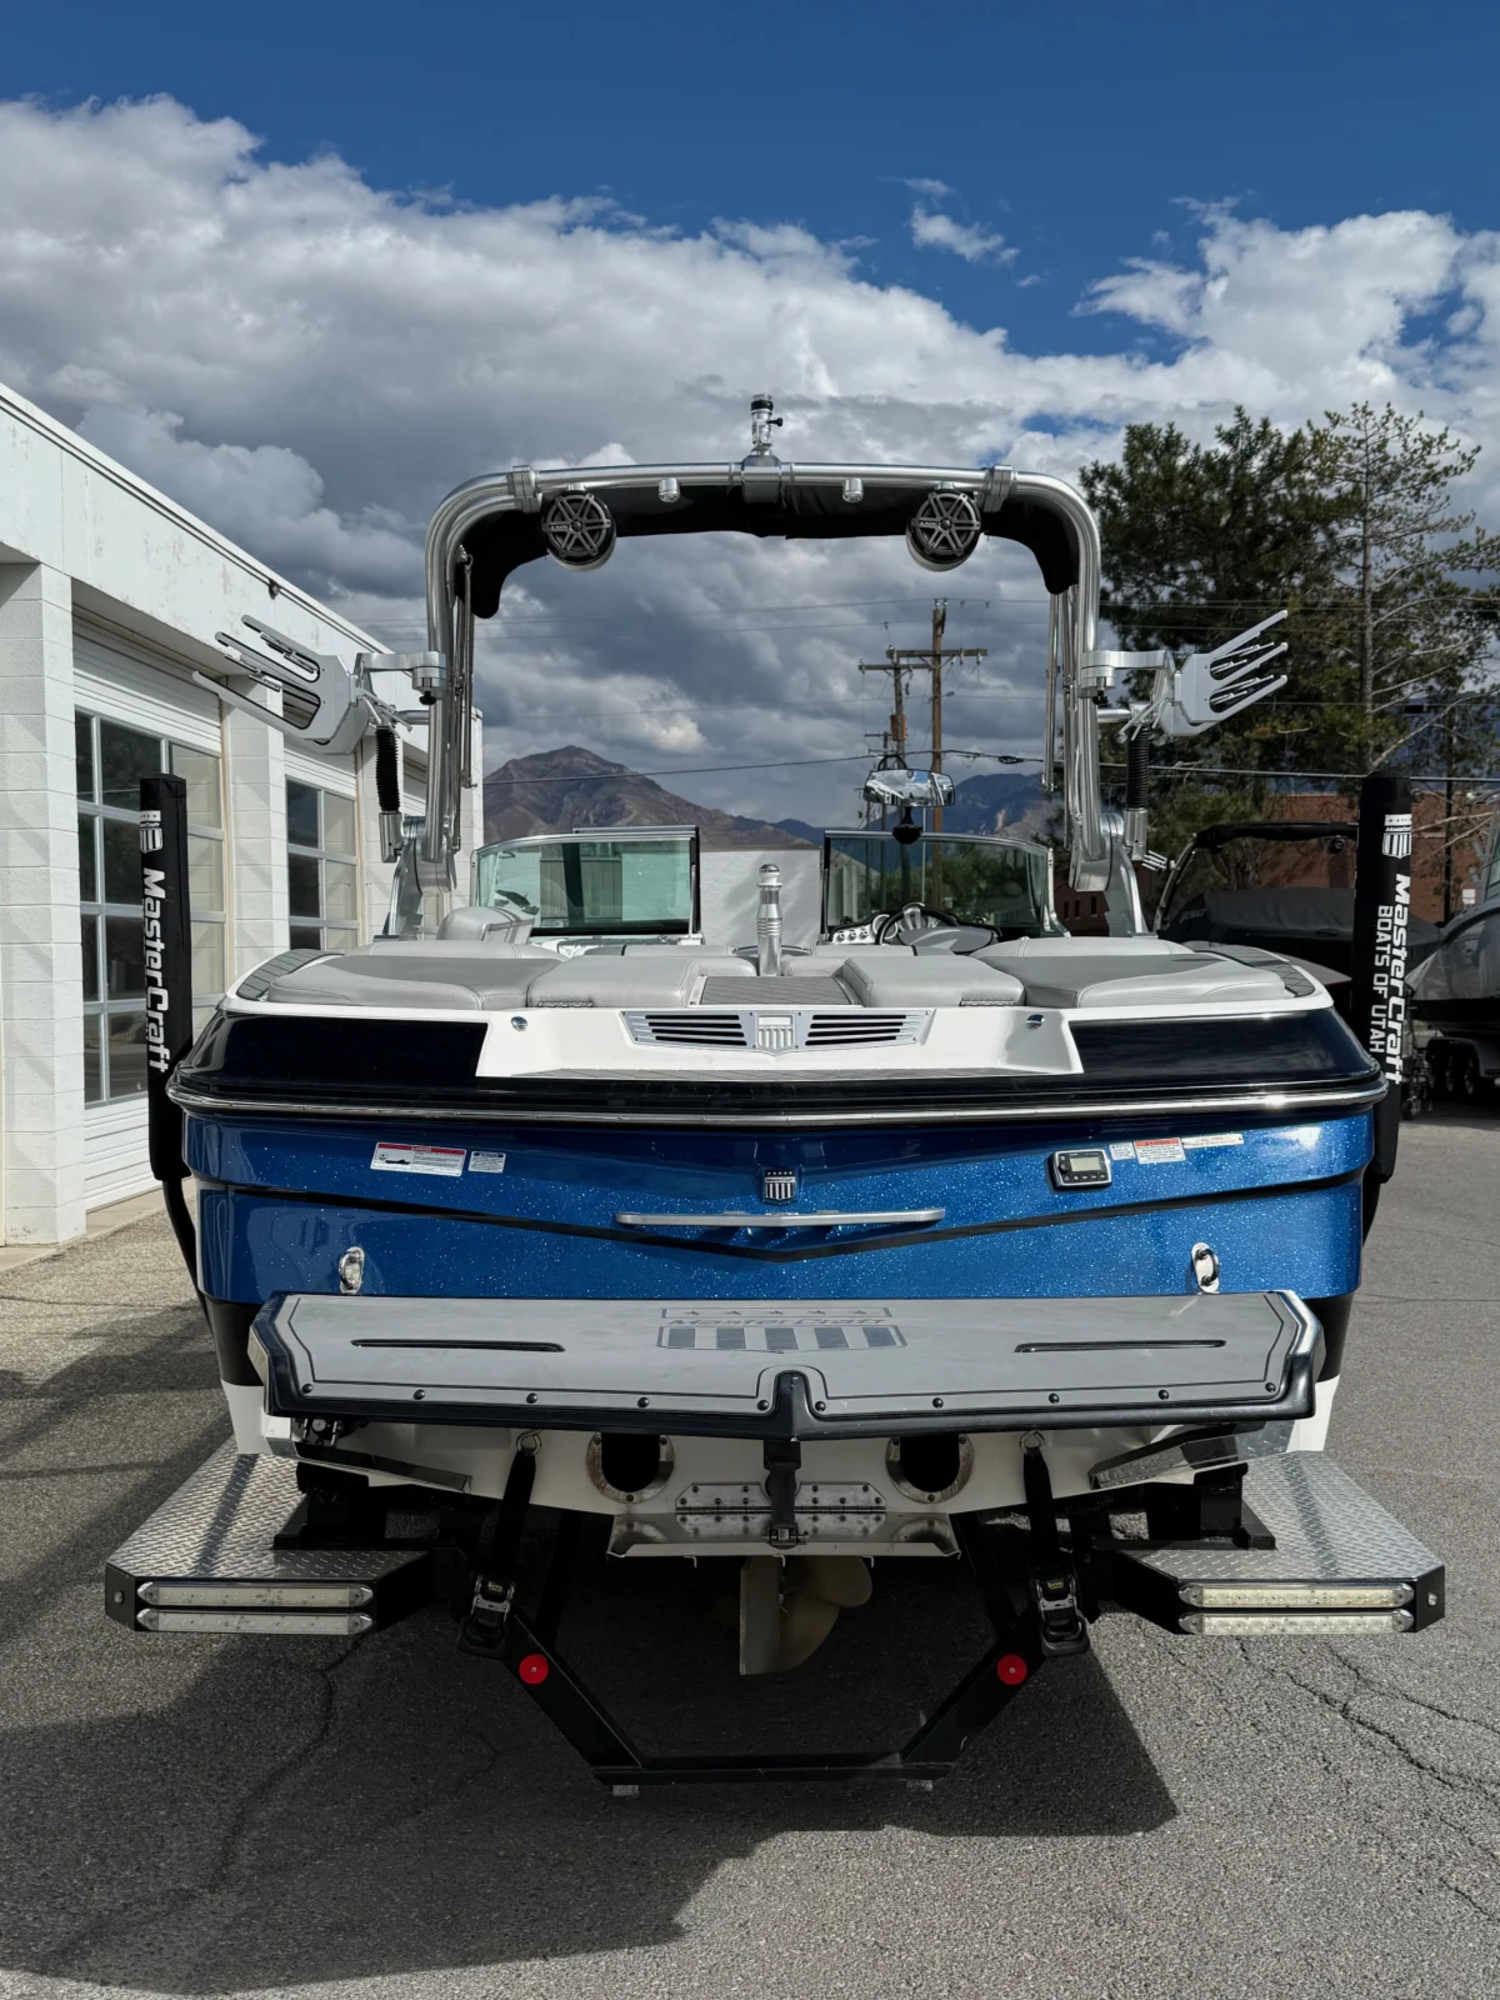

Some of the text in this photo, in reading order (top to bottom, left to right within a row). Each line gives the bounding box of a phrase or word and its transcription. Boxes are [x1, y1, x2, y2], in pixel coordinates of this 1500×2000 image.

[143, 867, 170, 1073] MasterCraft
[1369, 904, 1393, 1054] BOATS OF UTAH
[1385, 873, 1411, 1085] MasterCraft
